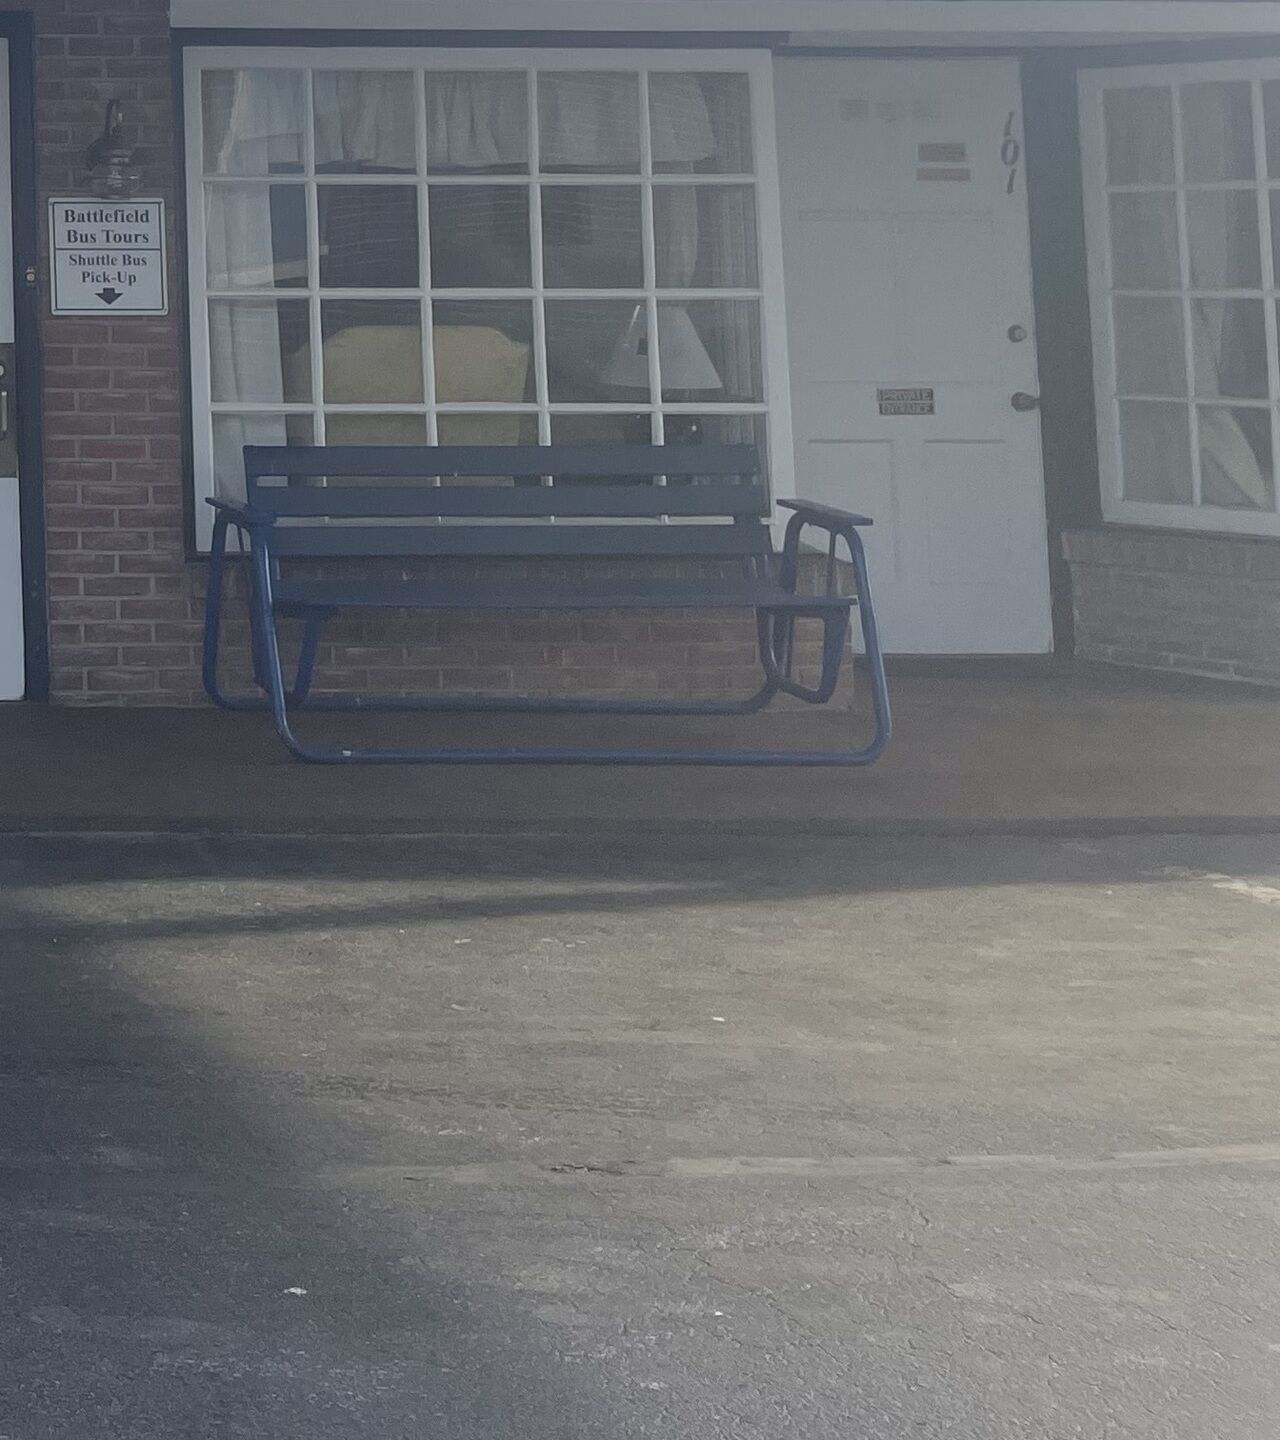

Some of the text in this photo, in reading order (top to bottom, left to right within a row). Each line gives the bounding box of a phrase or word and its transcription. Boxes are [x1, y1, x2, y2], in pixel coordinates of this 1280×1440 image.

[64, 209, 149, 223] Battlefield
[67, 229, 149, 244] Bus Tours
[68, 254, 147, 266] Shuttle Bus
[82, 271, 137, 287] Pick-Up
